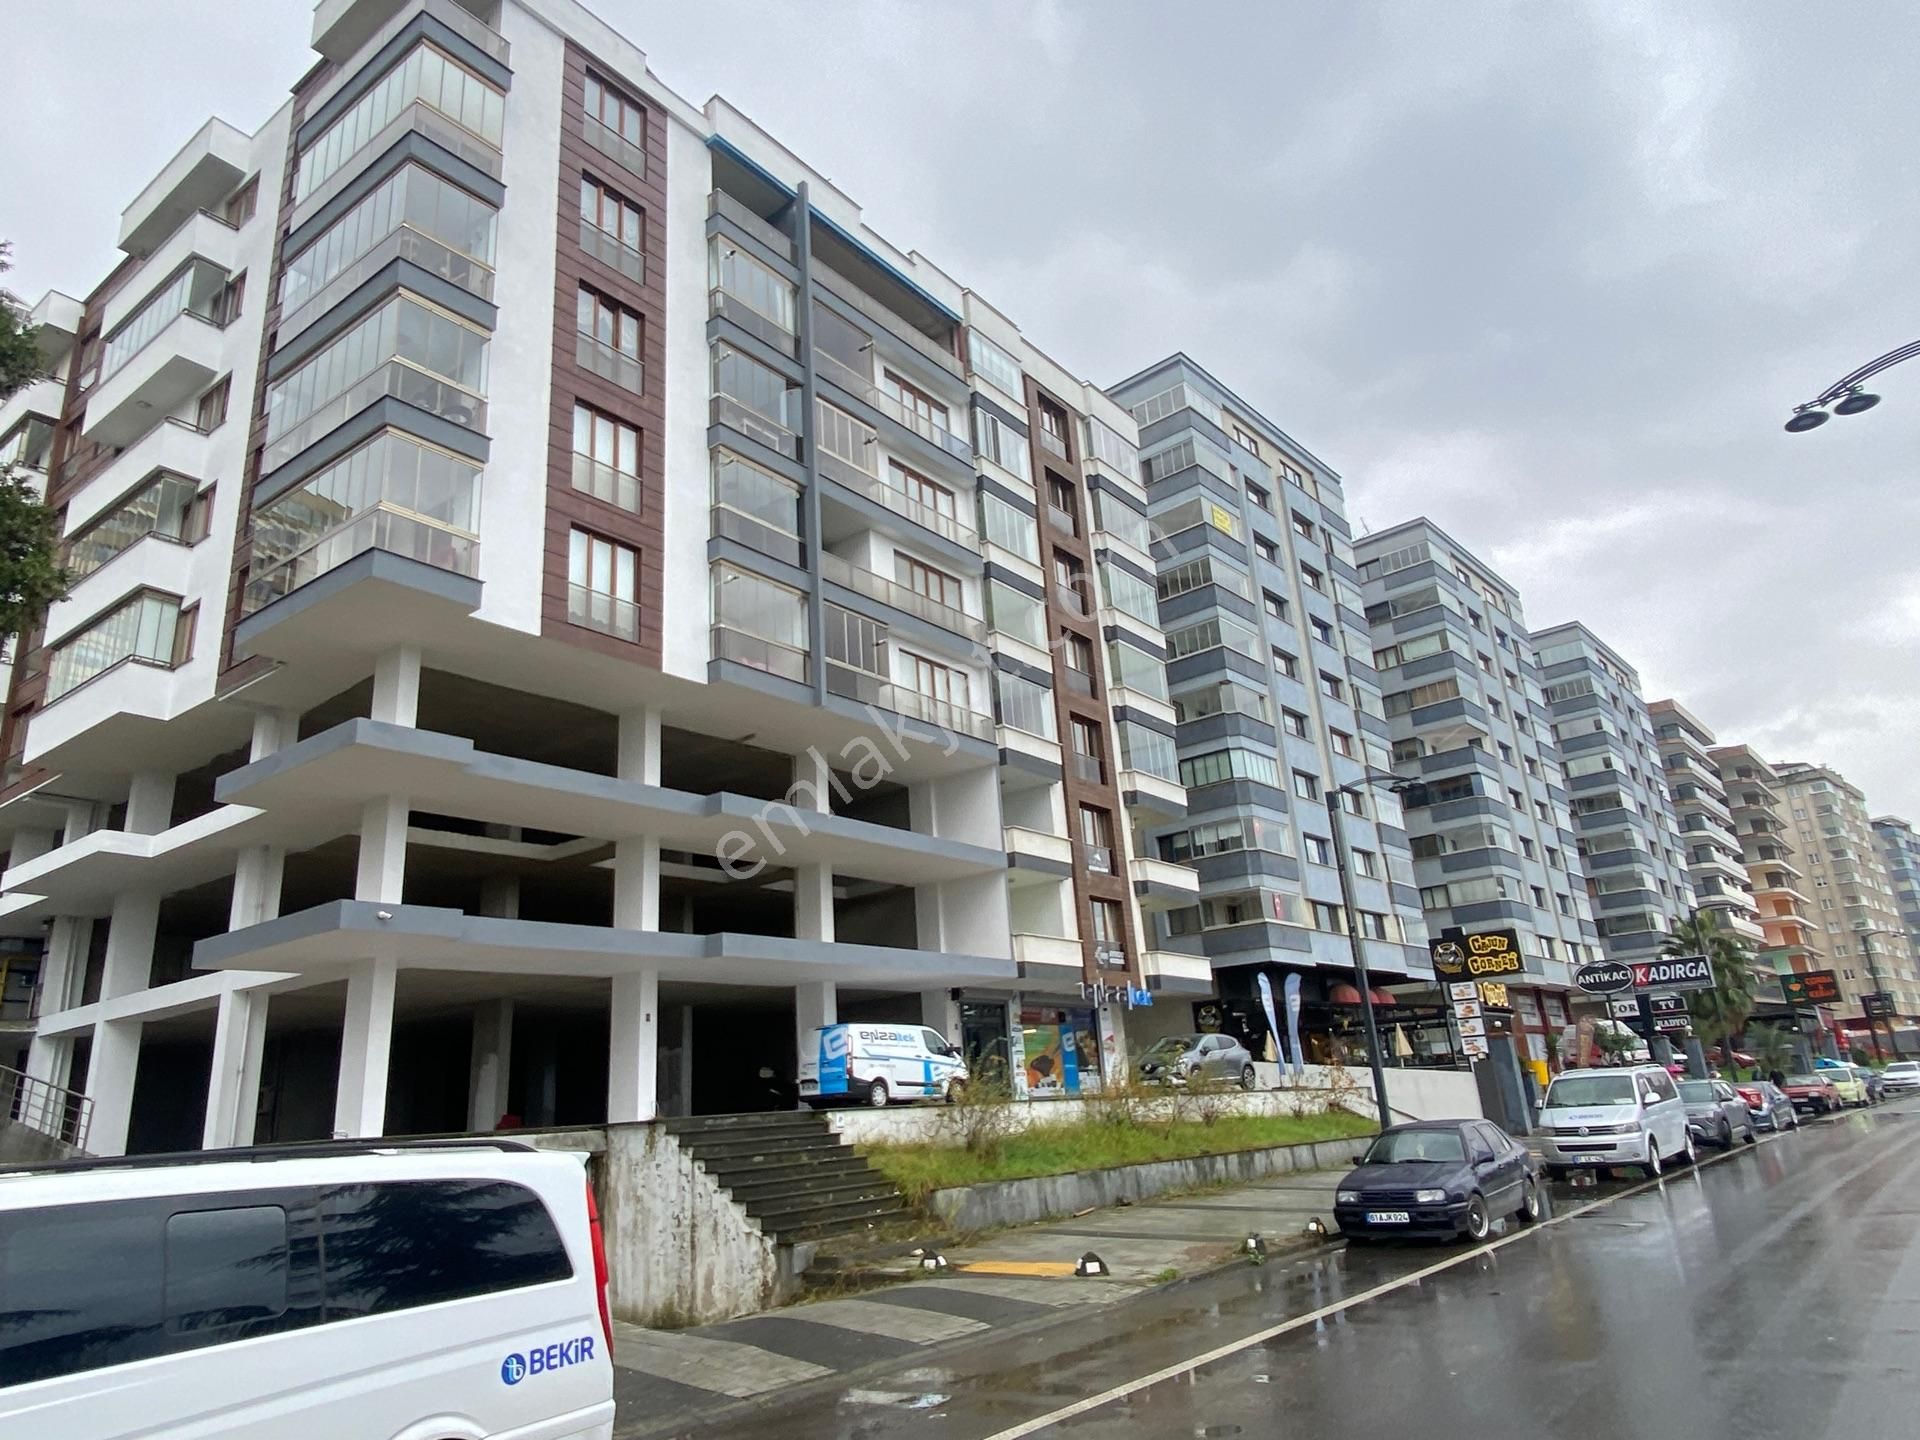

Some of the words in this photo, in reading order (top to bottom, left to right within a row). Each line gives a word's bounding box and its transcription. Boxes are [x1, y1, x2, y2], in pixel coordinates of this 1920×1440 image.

[1635, 961, 1709, 983] KADIRGA
[1658, 1000, 1675, 1010] TV
[1656, 1018, 1688, 1028] RADYO
